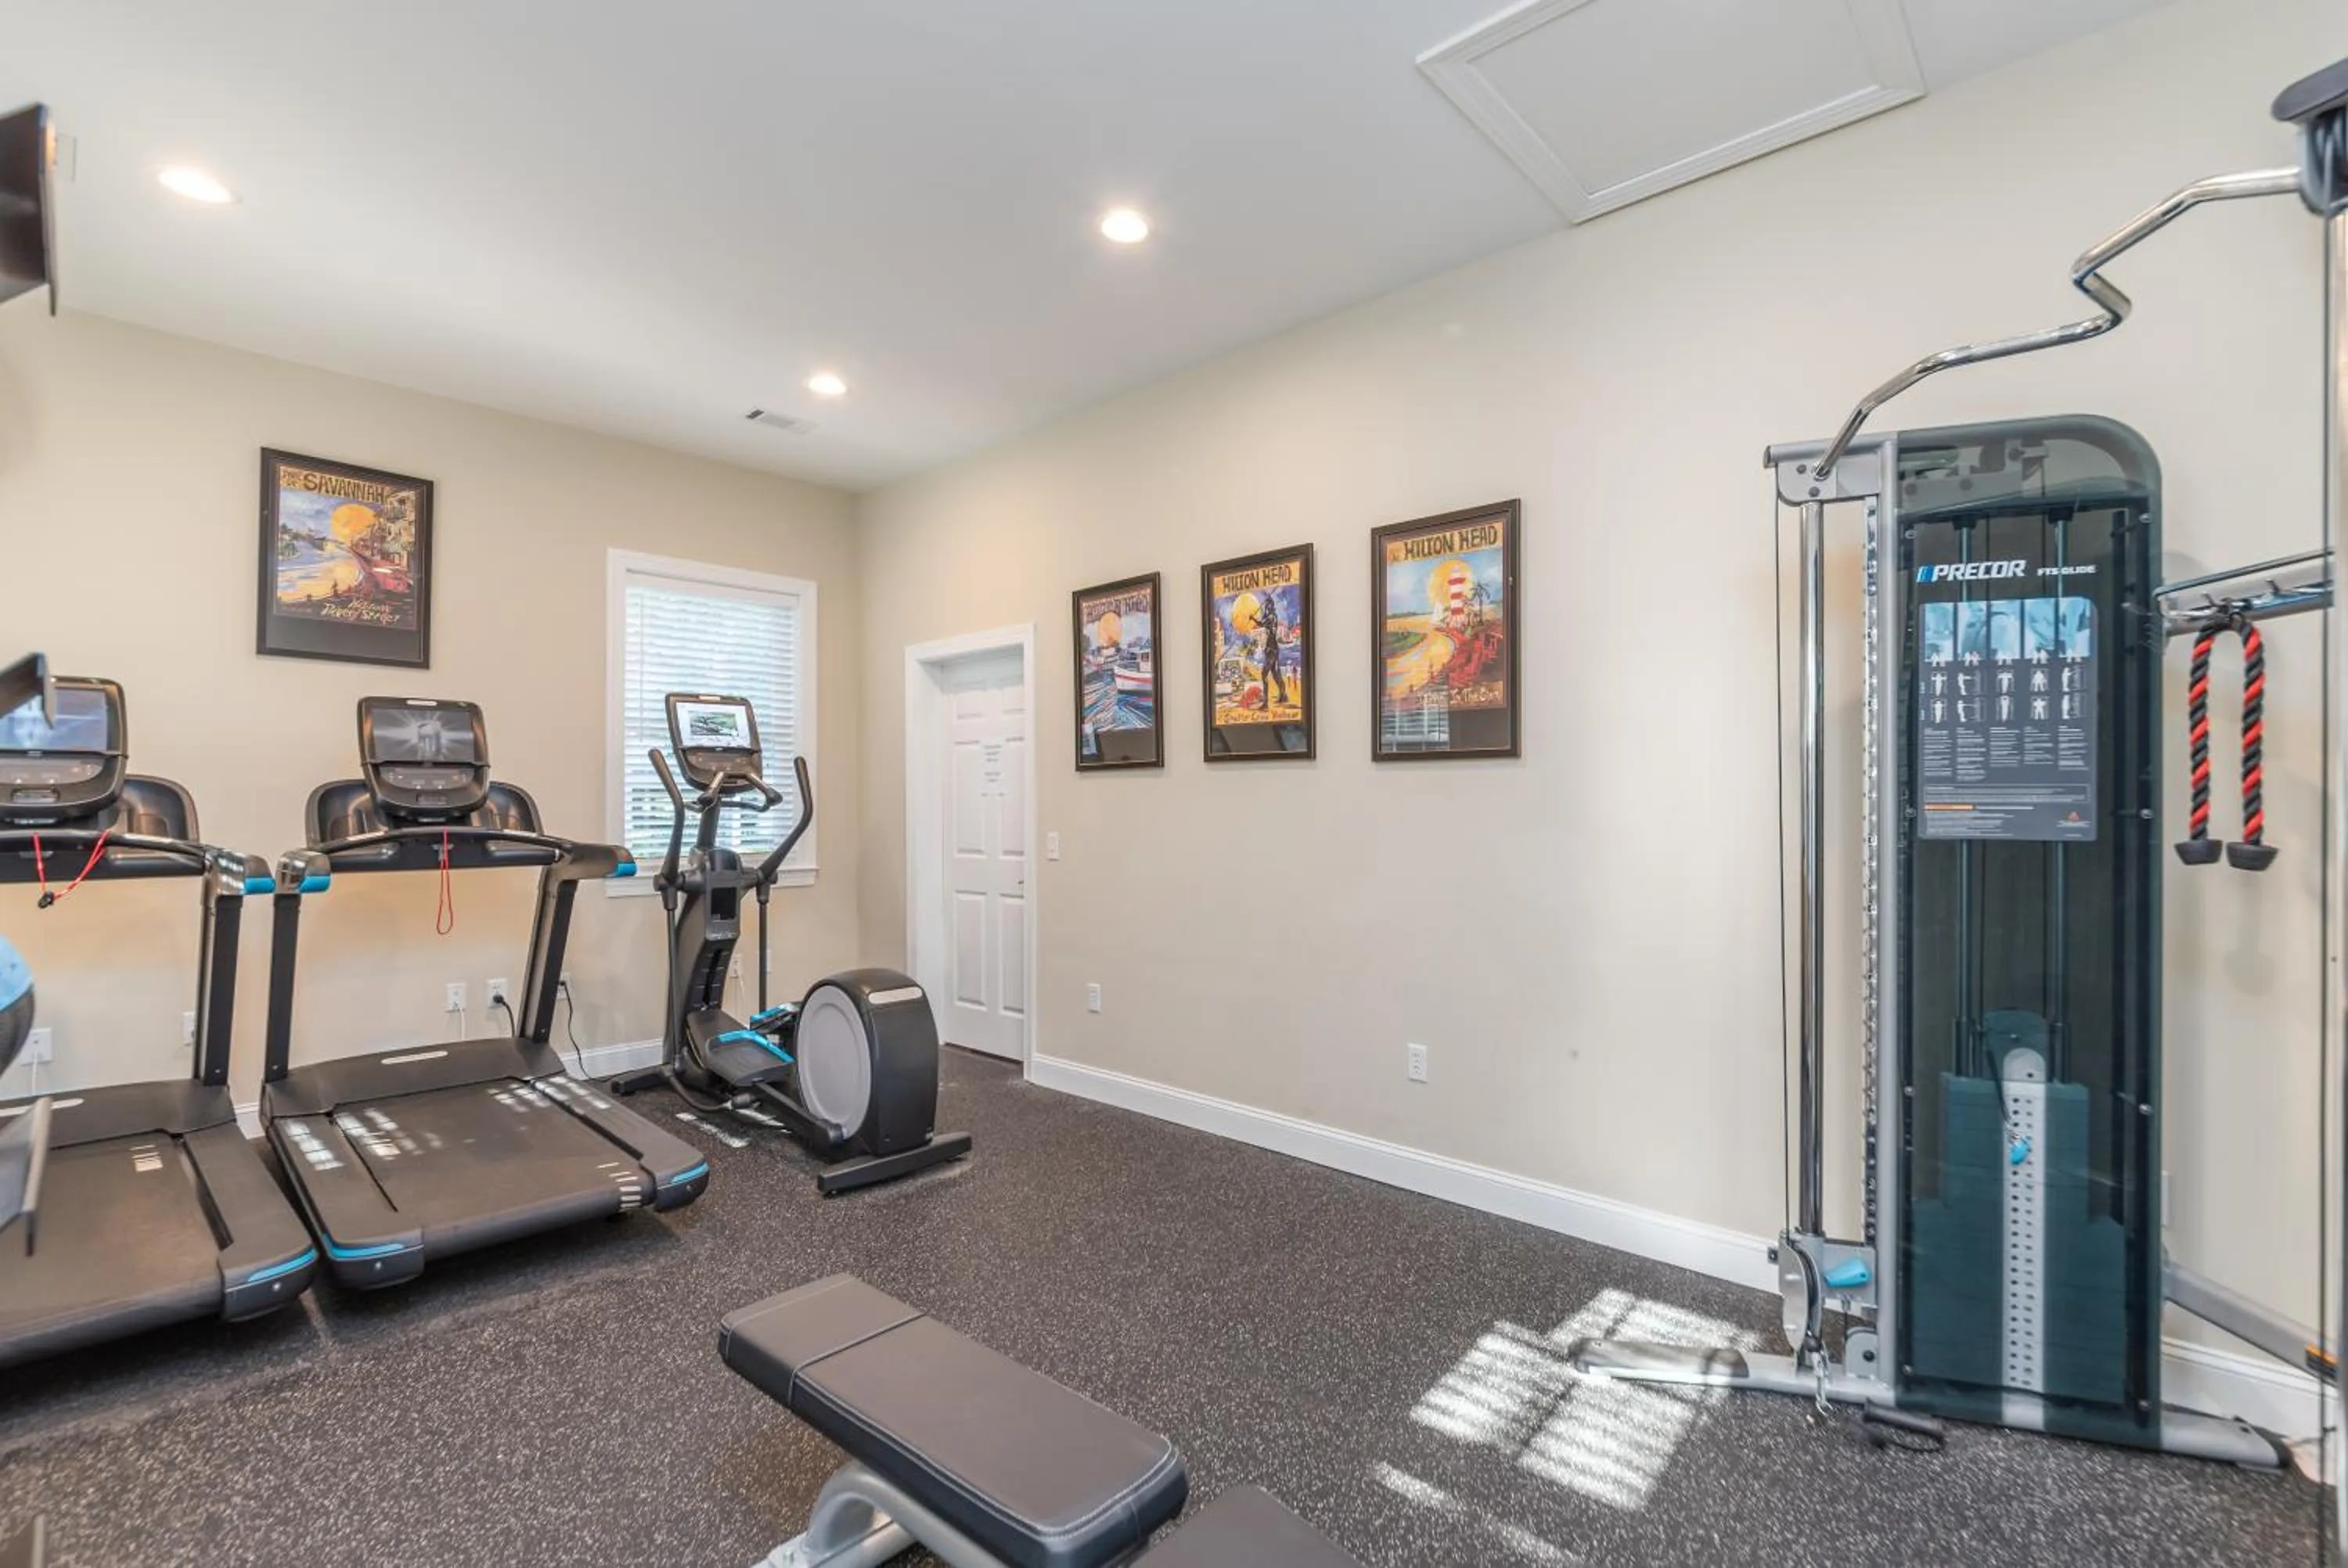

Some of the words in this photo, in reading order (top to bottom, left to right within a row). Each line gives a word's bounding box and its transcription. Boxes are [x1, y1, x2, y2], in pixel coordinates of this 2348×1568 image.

[303, 473, 385, 504] SAVANNAH
[1403, 534, 1454, 560] HILTON
[1457, 525, 1496, 551] HEAD
[1223, 571, 1259, 593] HILTON
[1262, 565, 1291, 588] HEAD
[1932, 559, 2027, 581] PRECOR
[2061, 565, 2097, 576] GLIDE
